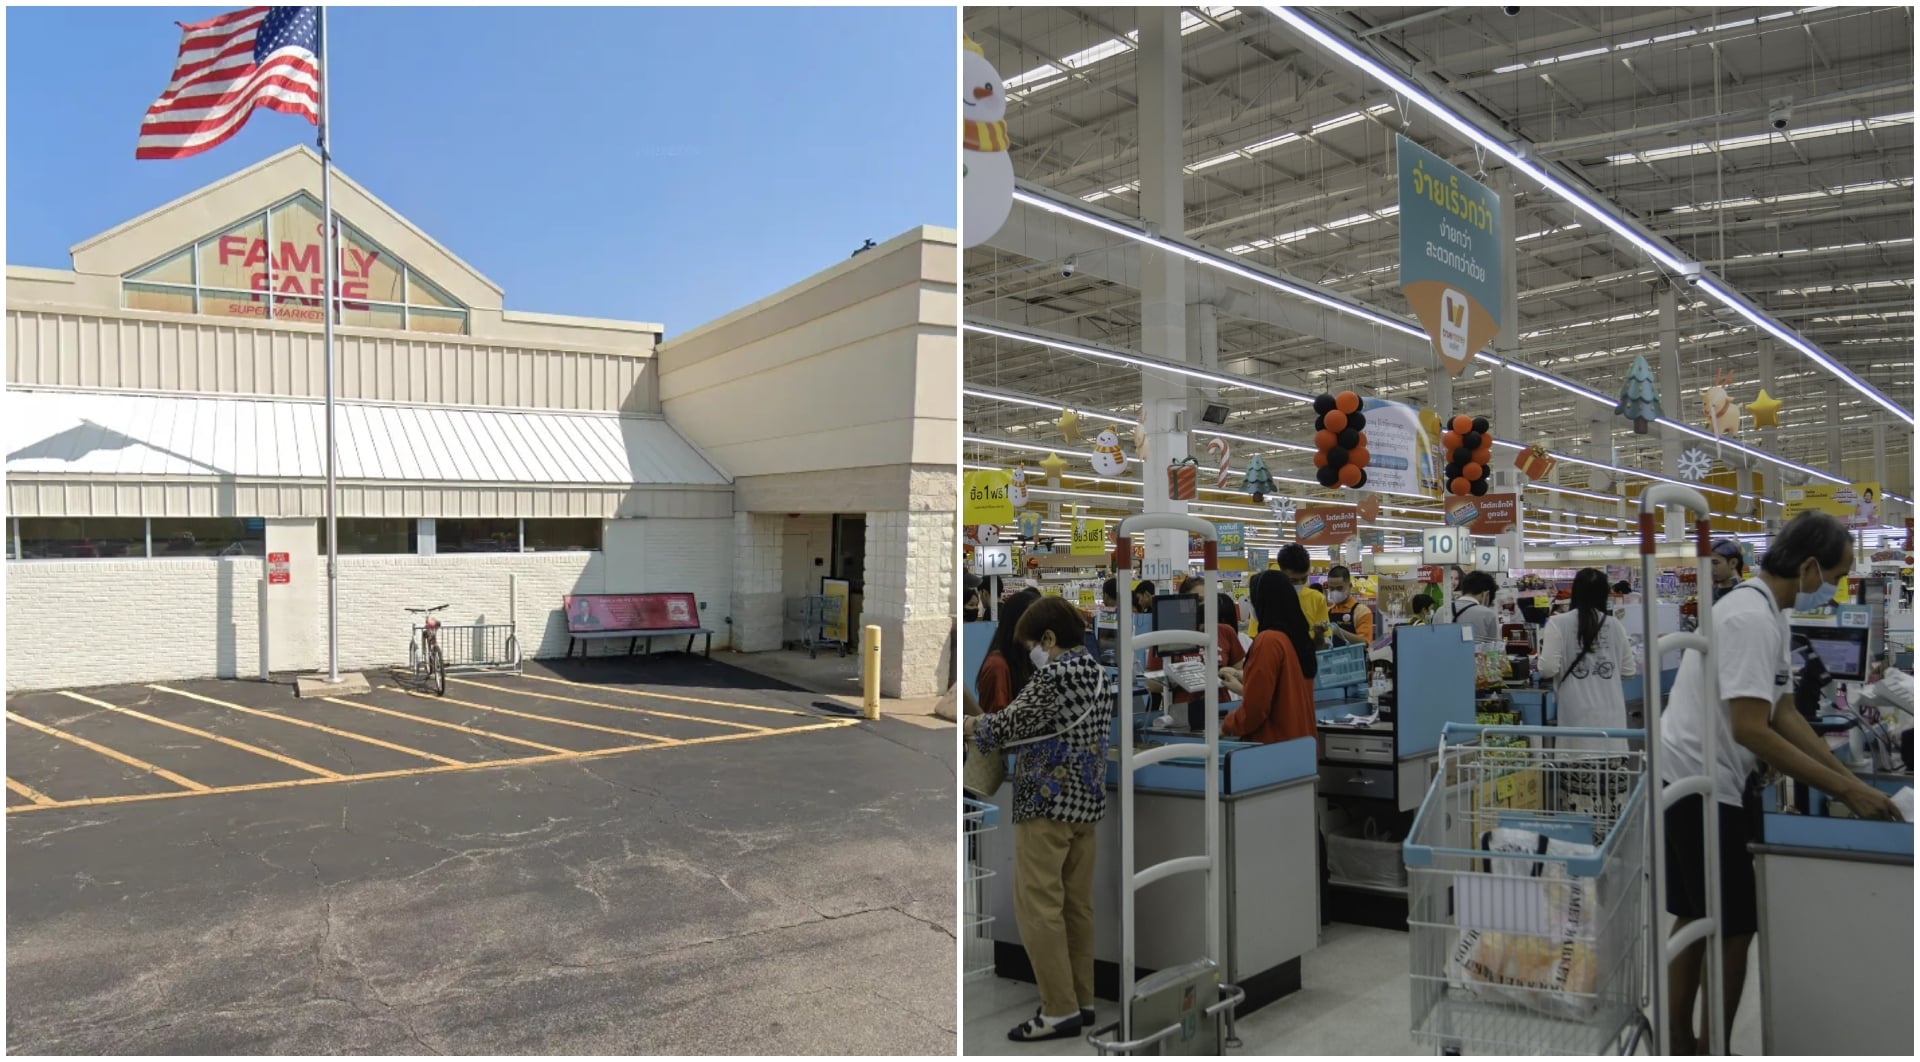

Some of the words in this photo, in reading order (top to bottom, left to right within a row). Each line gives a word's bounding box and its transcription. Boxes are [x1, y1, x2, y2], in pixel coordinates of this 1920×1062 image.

[1412, 160, 1493, 236] จ่ายเร็วกว่า
[1440, 217, 1472, 251] ง่ายกว่า
[218, 235, 379, 278] FAMLY
[1426, 241, 1486, 283] สะดวกกว่าด้วย
[1221, 534, 1240, 545] 250
[1428, 534, 1453, 554] 10
[1460, 536, 1470, 555] 10
[976, 552, 983, 568] 12
[988, 552, 1007, 568] 12
[1482, 552, 1491, 566] 9
[1501, 554, 1506, 567] 9
[1144, 563, 1155, 575] 11
[1160, 563, 1169, 575] 11
[1380, 584, 1405, 592] PANTENE
